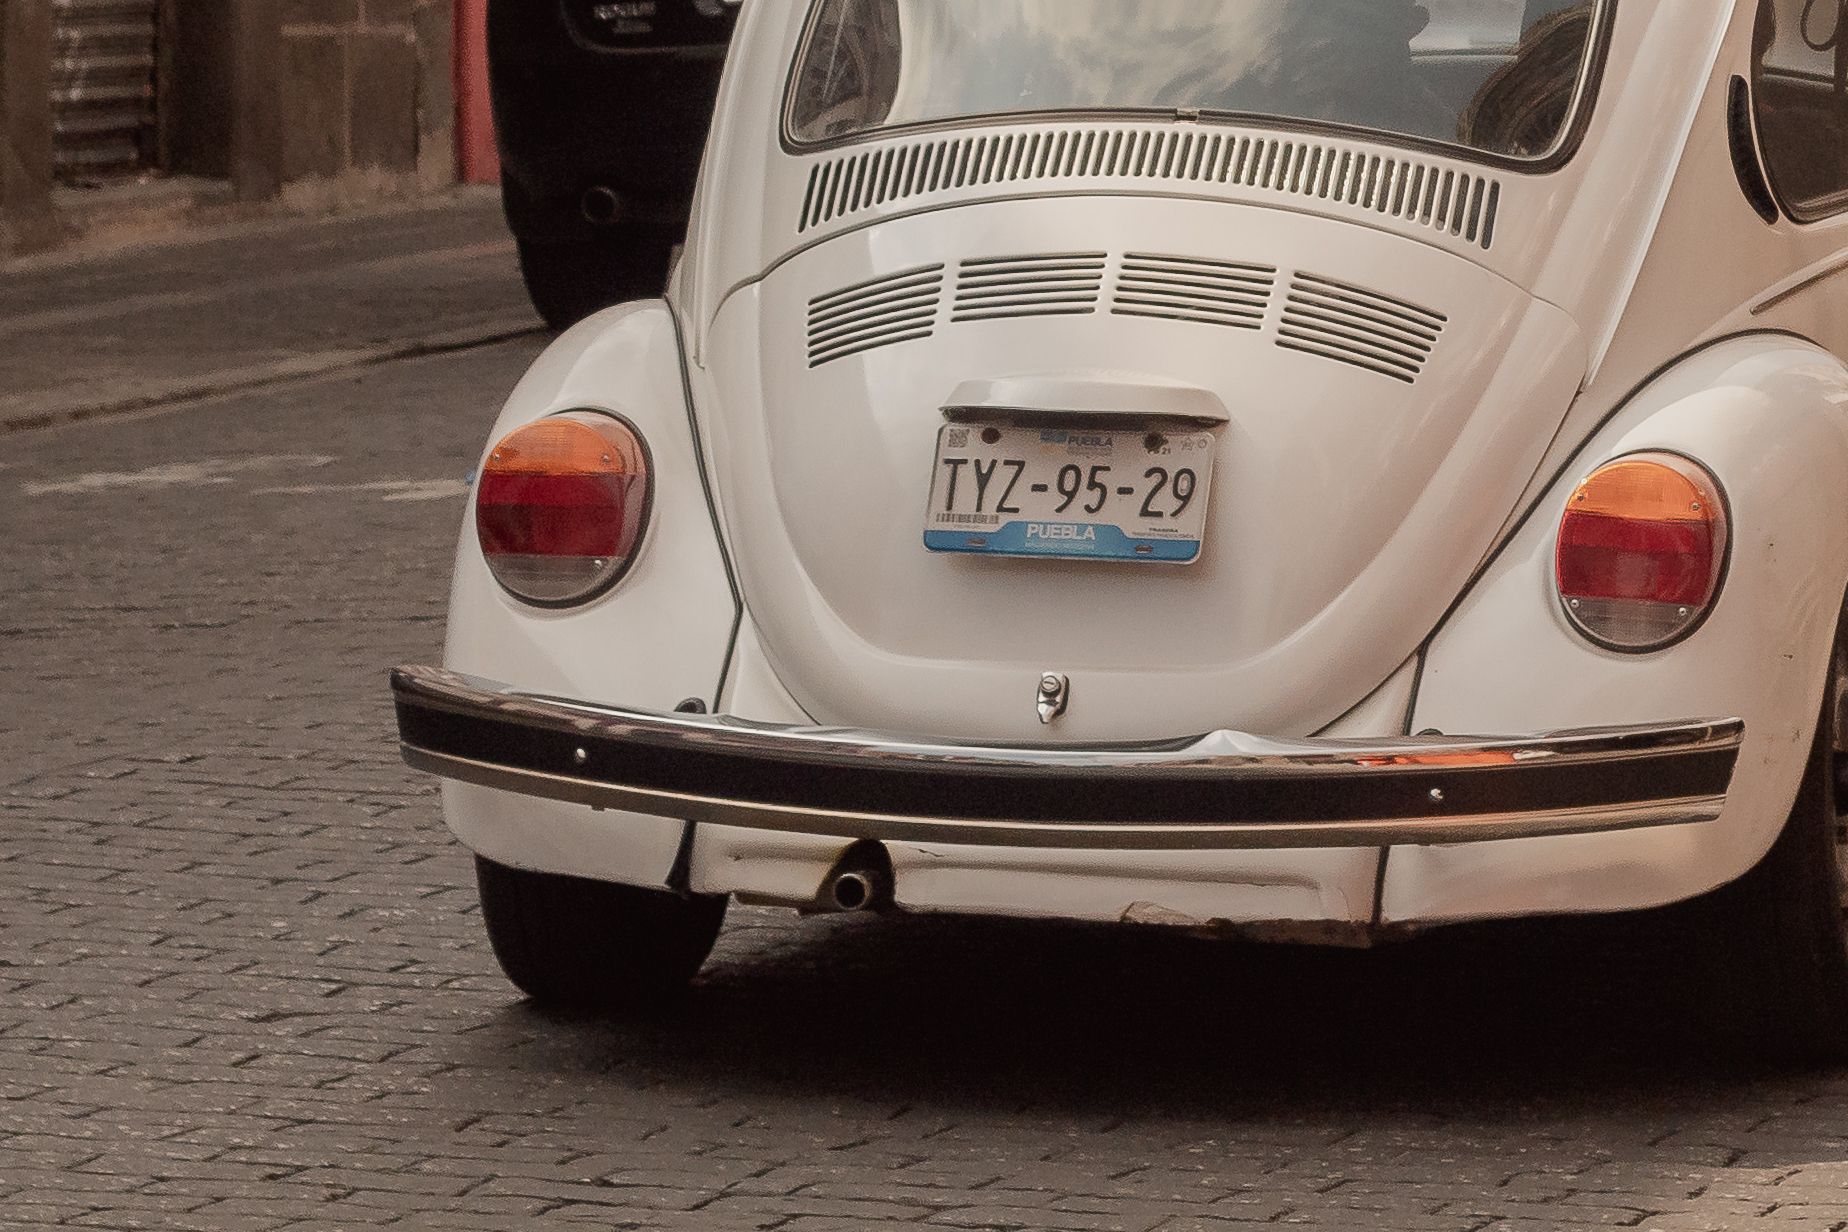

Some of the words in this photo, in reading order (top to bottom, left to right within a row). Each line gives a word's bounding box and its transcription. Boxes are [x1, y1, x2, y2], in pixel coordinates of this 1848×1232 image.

[1067, 434, 1113, 448] PUEBLA
[943, 458, 1197, 518] TYZ-95-29
[1026, 523, 1096, 541] PUEBLA
